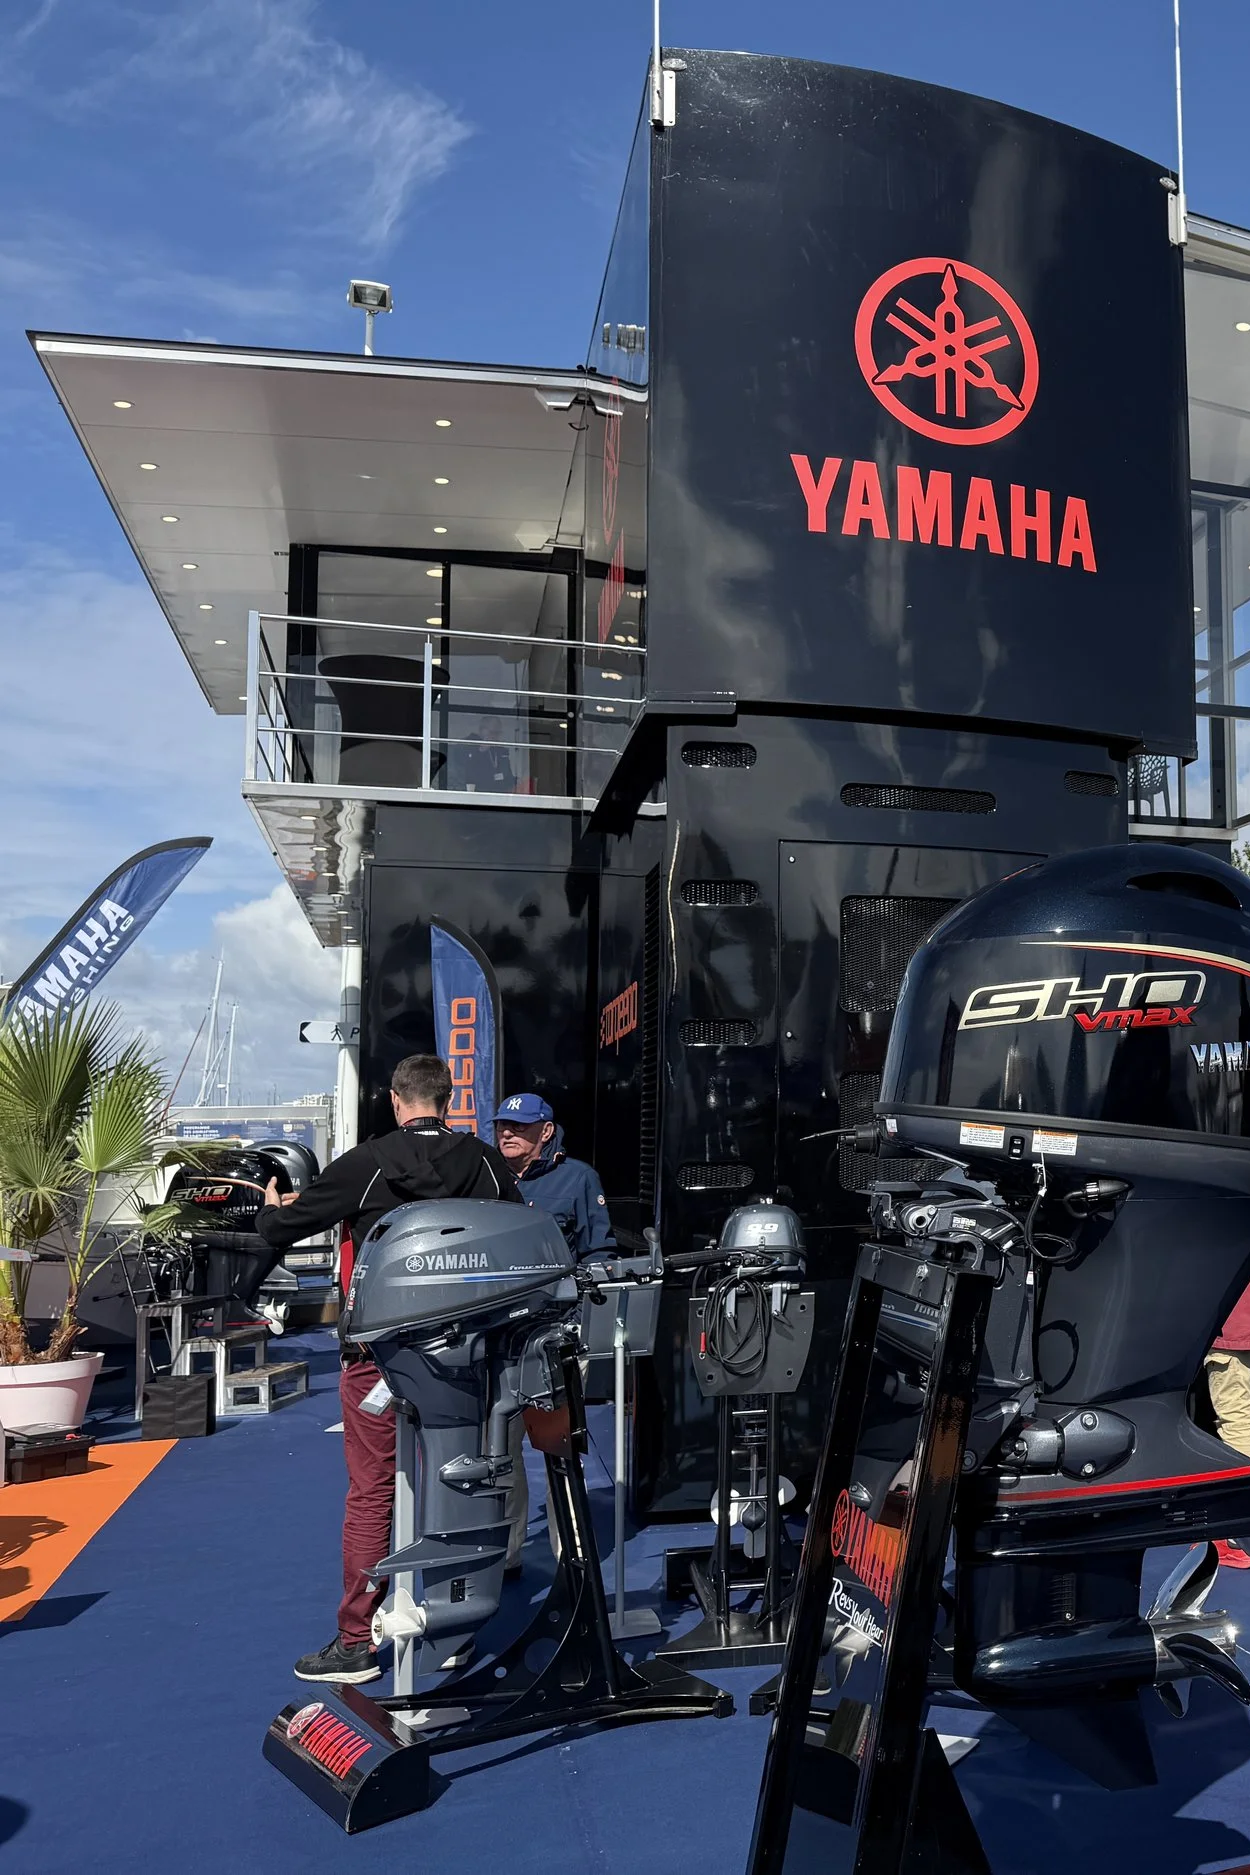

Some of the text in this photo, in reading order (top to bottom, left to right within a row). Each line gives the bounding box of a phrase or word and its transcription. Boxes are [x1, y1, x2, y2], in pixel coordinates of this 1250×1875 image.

[790, 453, 1098, 573] YAMAHA
[63, 915, 135, 1013] ISHING
[958, 971, 1206, 1031] SHO
[425, 1252, 489, 1271] YAMAHA
[844, 1502, 899, 1608] YAMAH
[866, 1614, 885, 1643] Hear
[299, 1711, 373, 1780] YAMAHA
